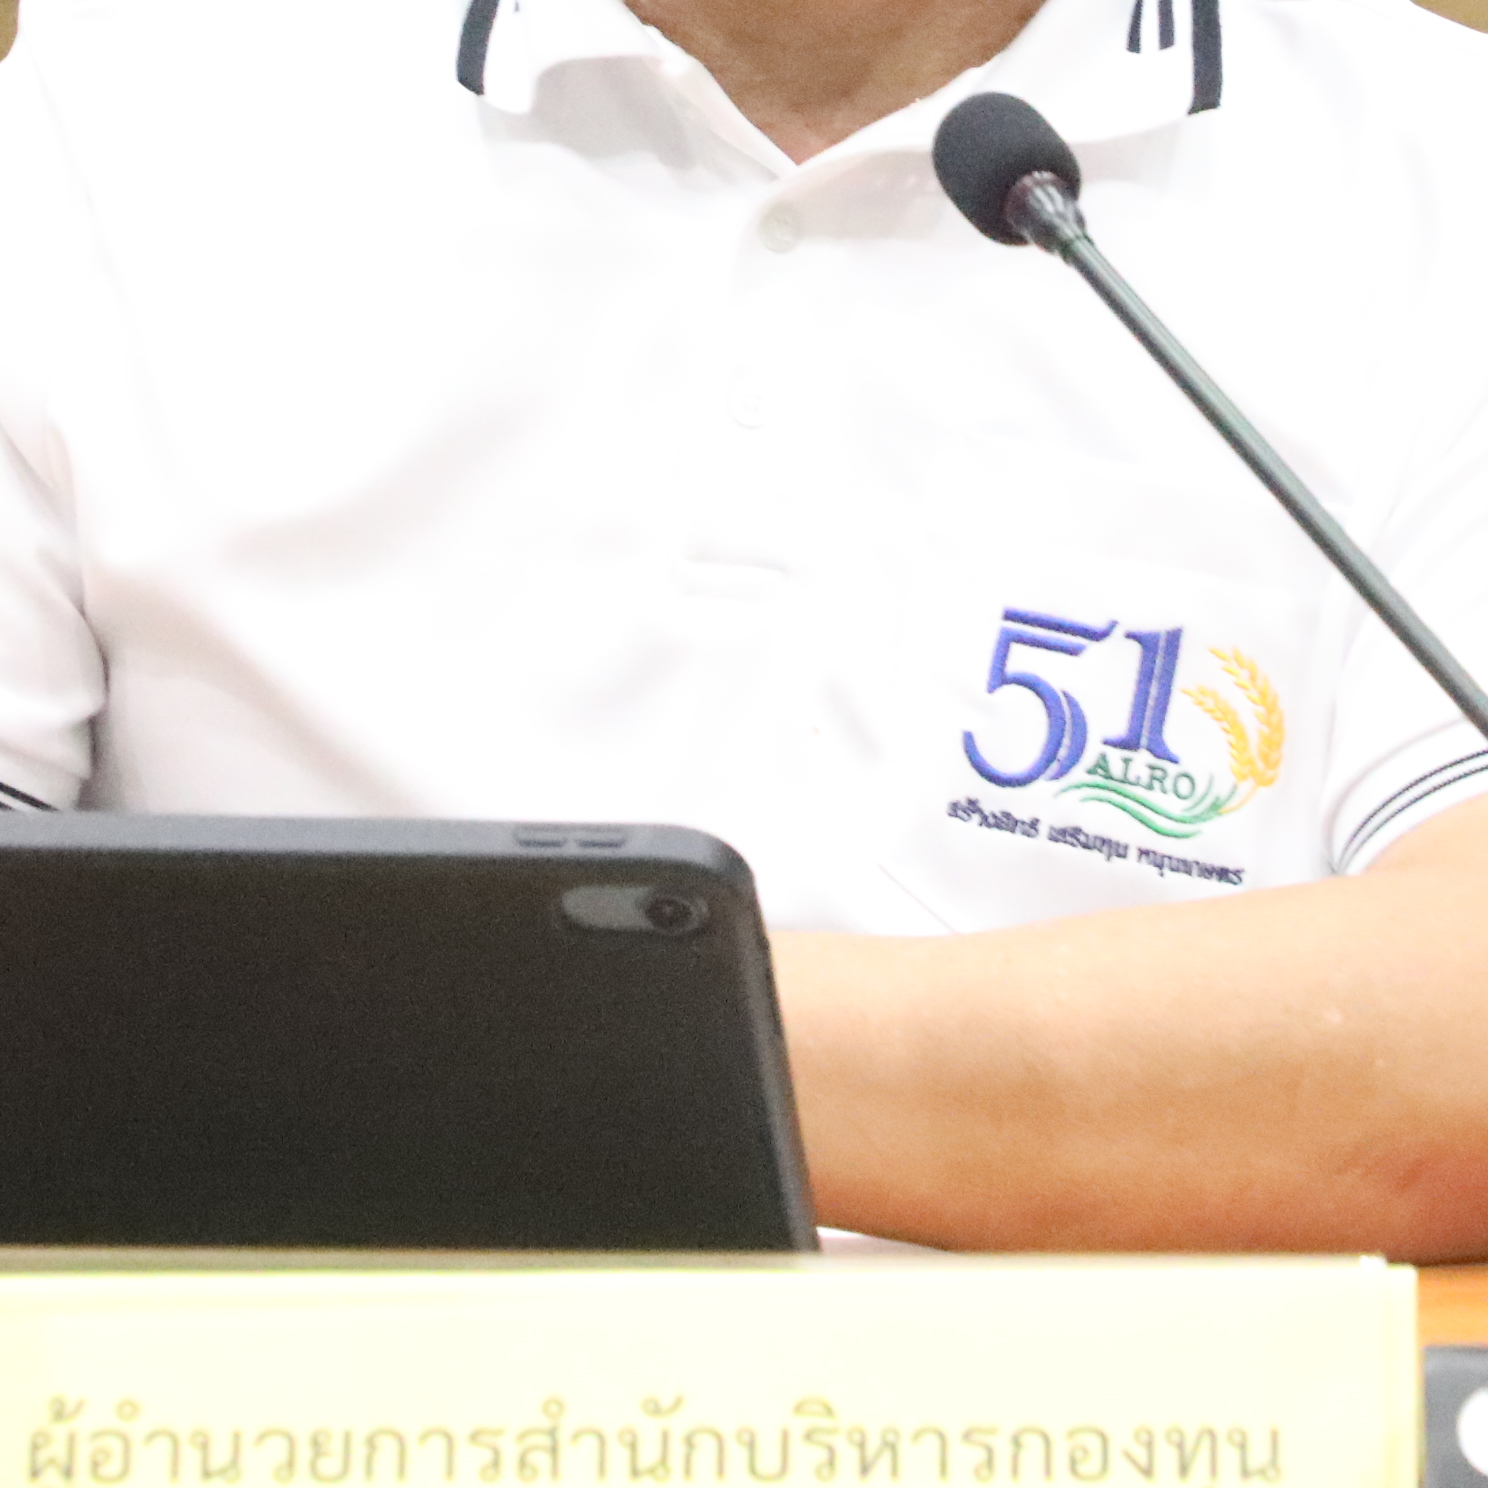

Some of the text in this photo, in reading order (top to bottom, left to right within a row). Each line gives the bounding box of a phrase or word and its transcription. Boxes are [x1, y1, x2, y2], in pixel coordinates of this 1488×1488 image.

[961, 606, 1184, 788] 51
[1084, 752, 1196, 801] ALRO
[28, 1394, 1283, 1488] ผ้อำนวยการสำนักบริหารกองทน
